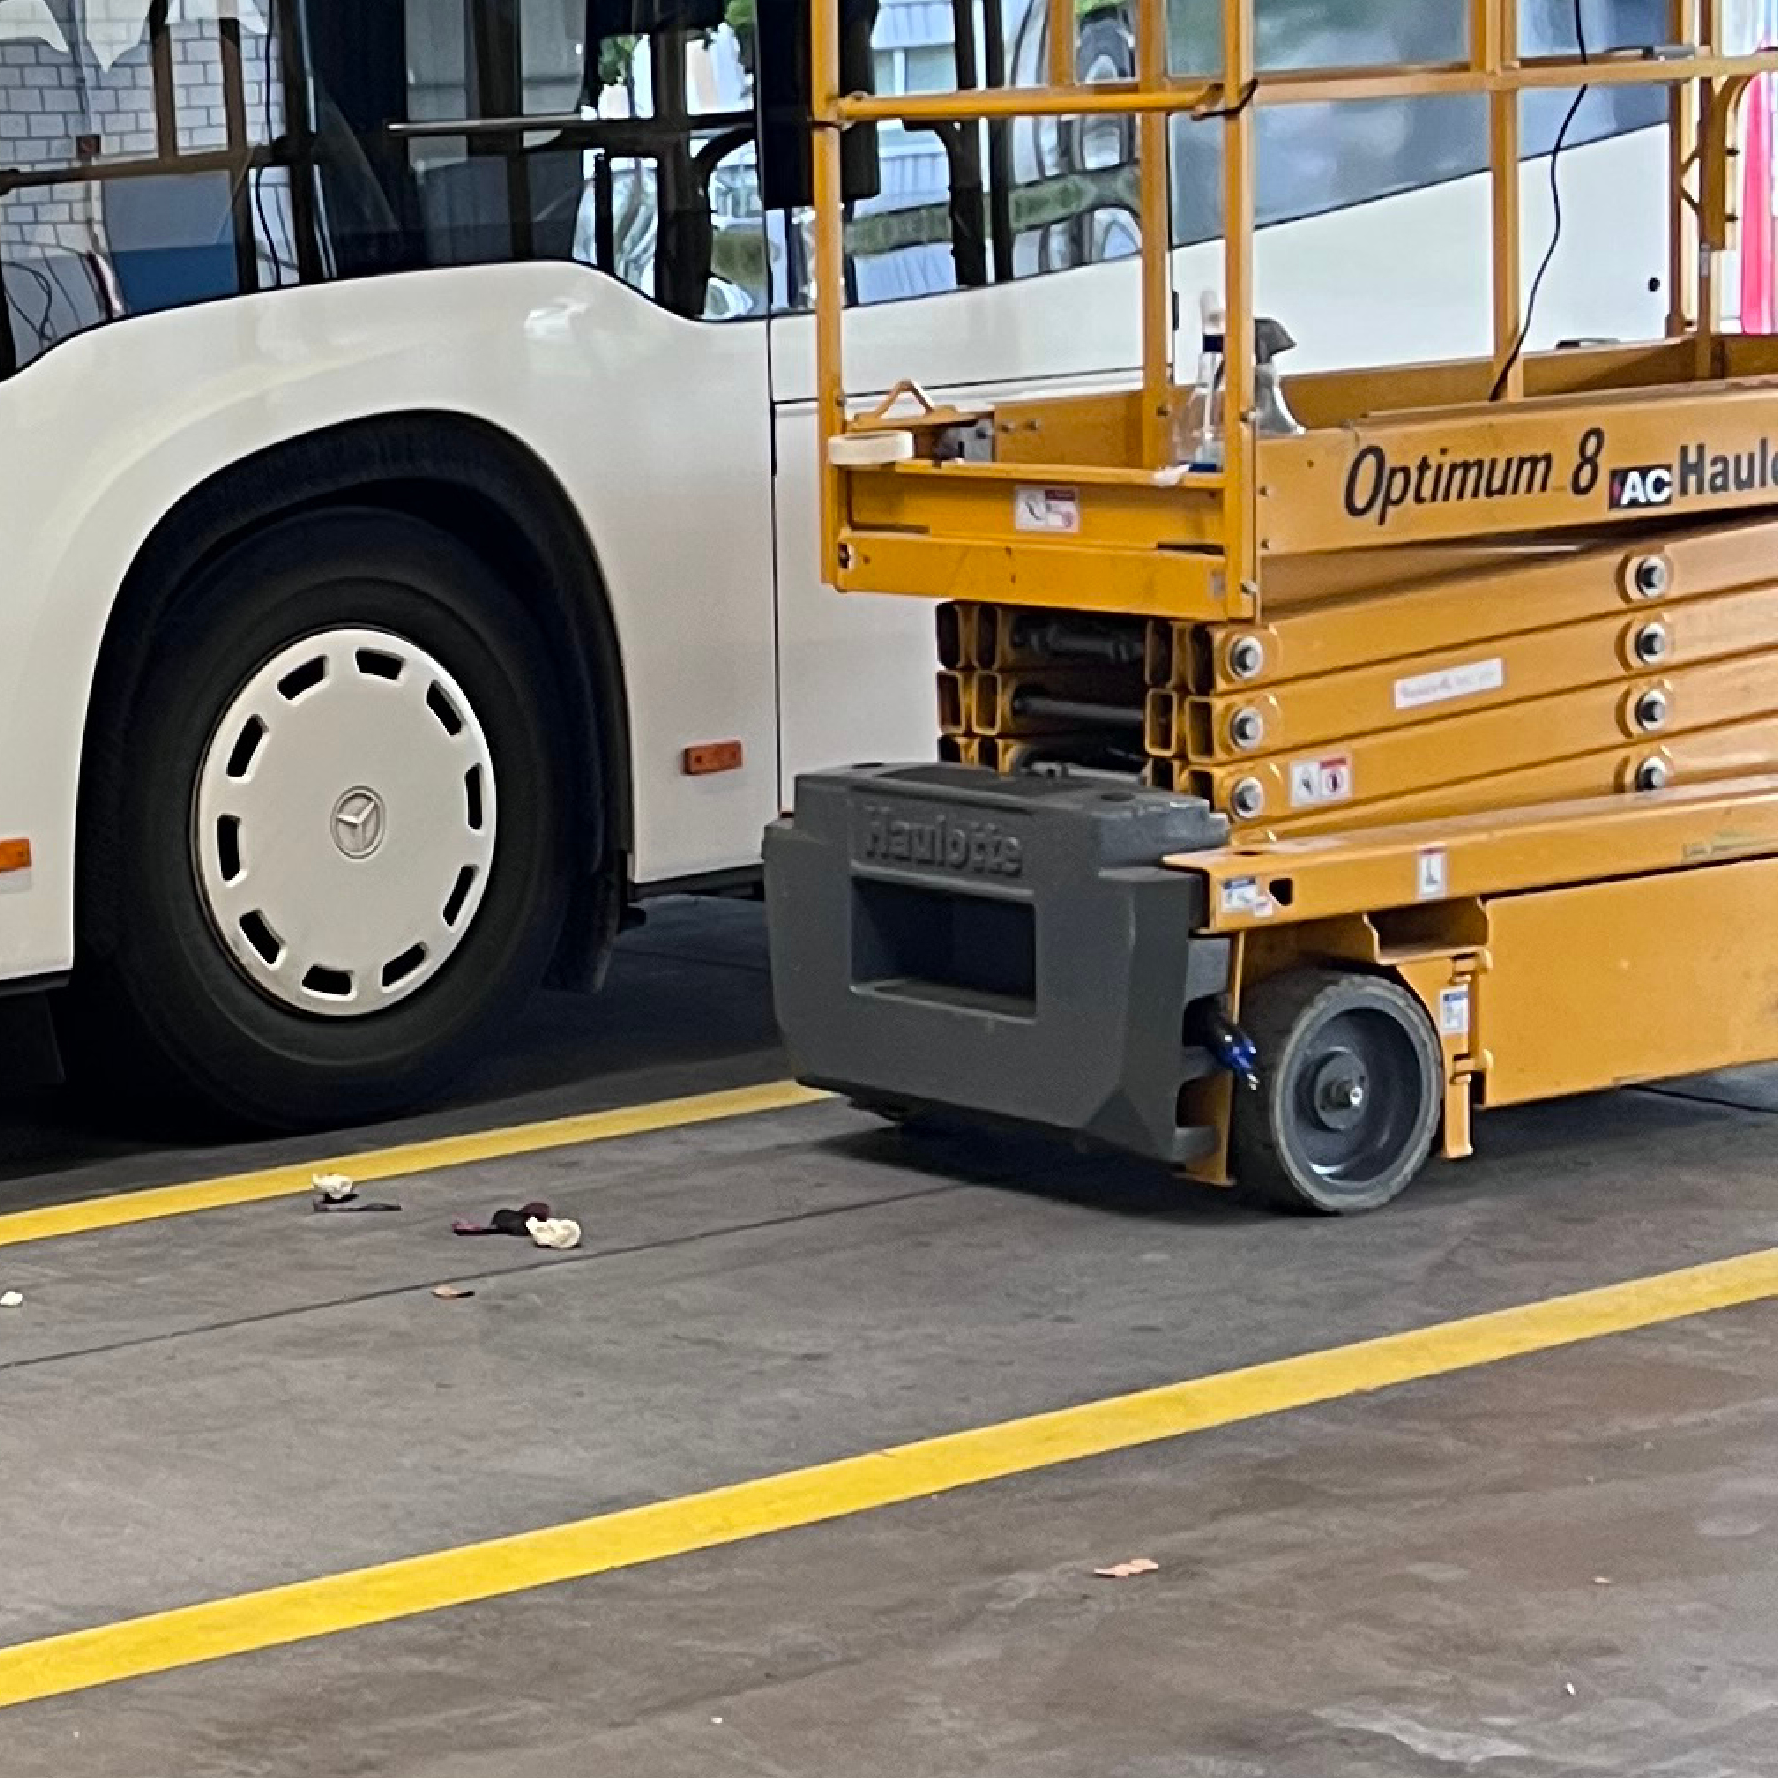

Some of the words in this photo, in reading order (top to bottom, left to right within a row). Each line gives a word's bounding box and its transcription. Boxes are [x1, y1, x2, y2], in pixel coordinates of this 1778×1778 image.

[1345, 445, 1552, 526] Optimum
[1571, 427, 1606, 496] 8
[864, 803, 1024, 878] Haulotte
